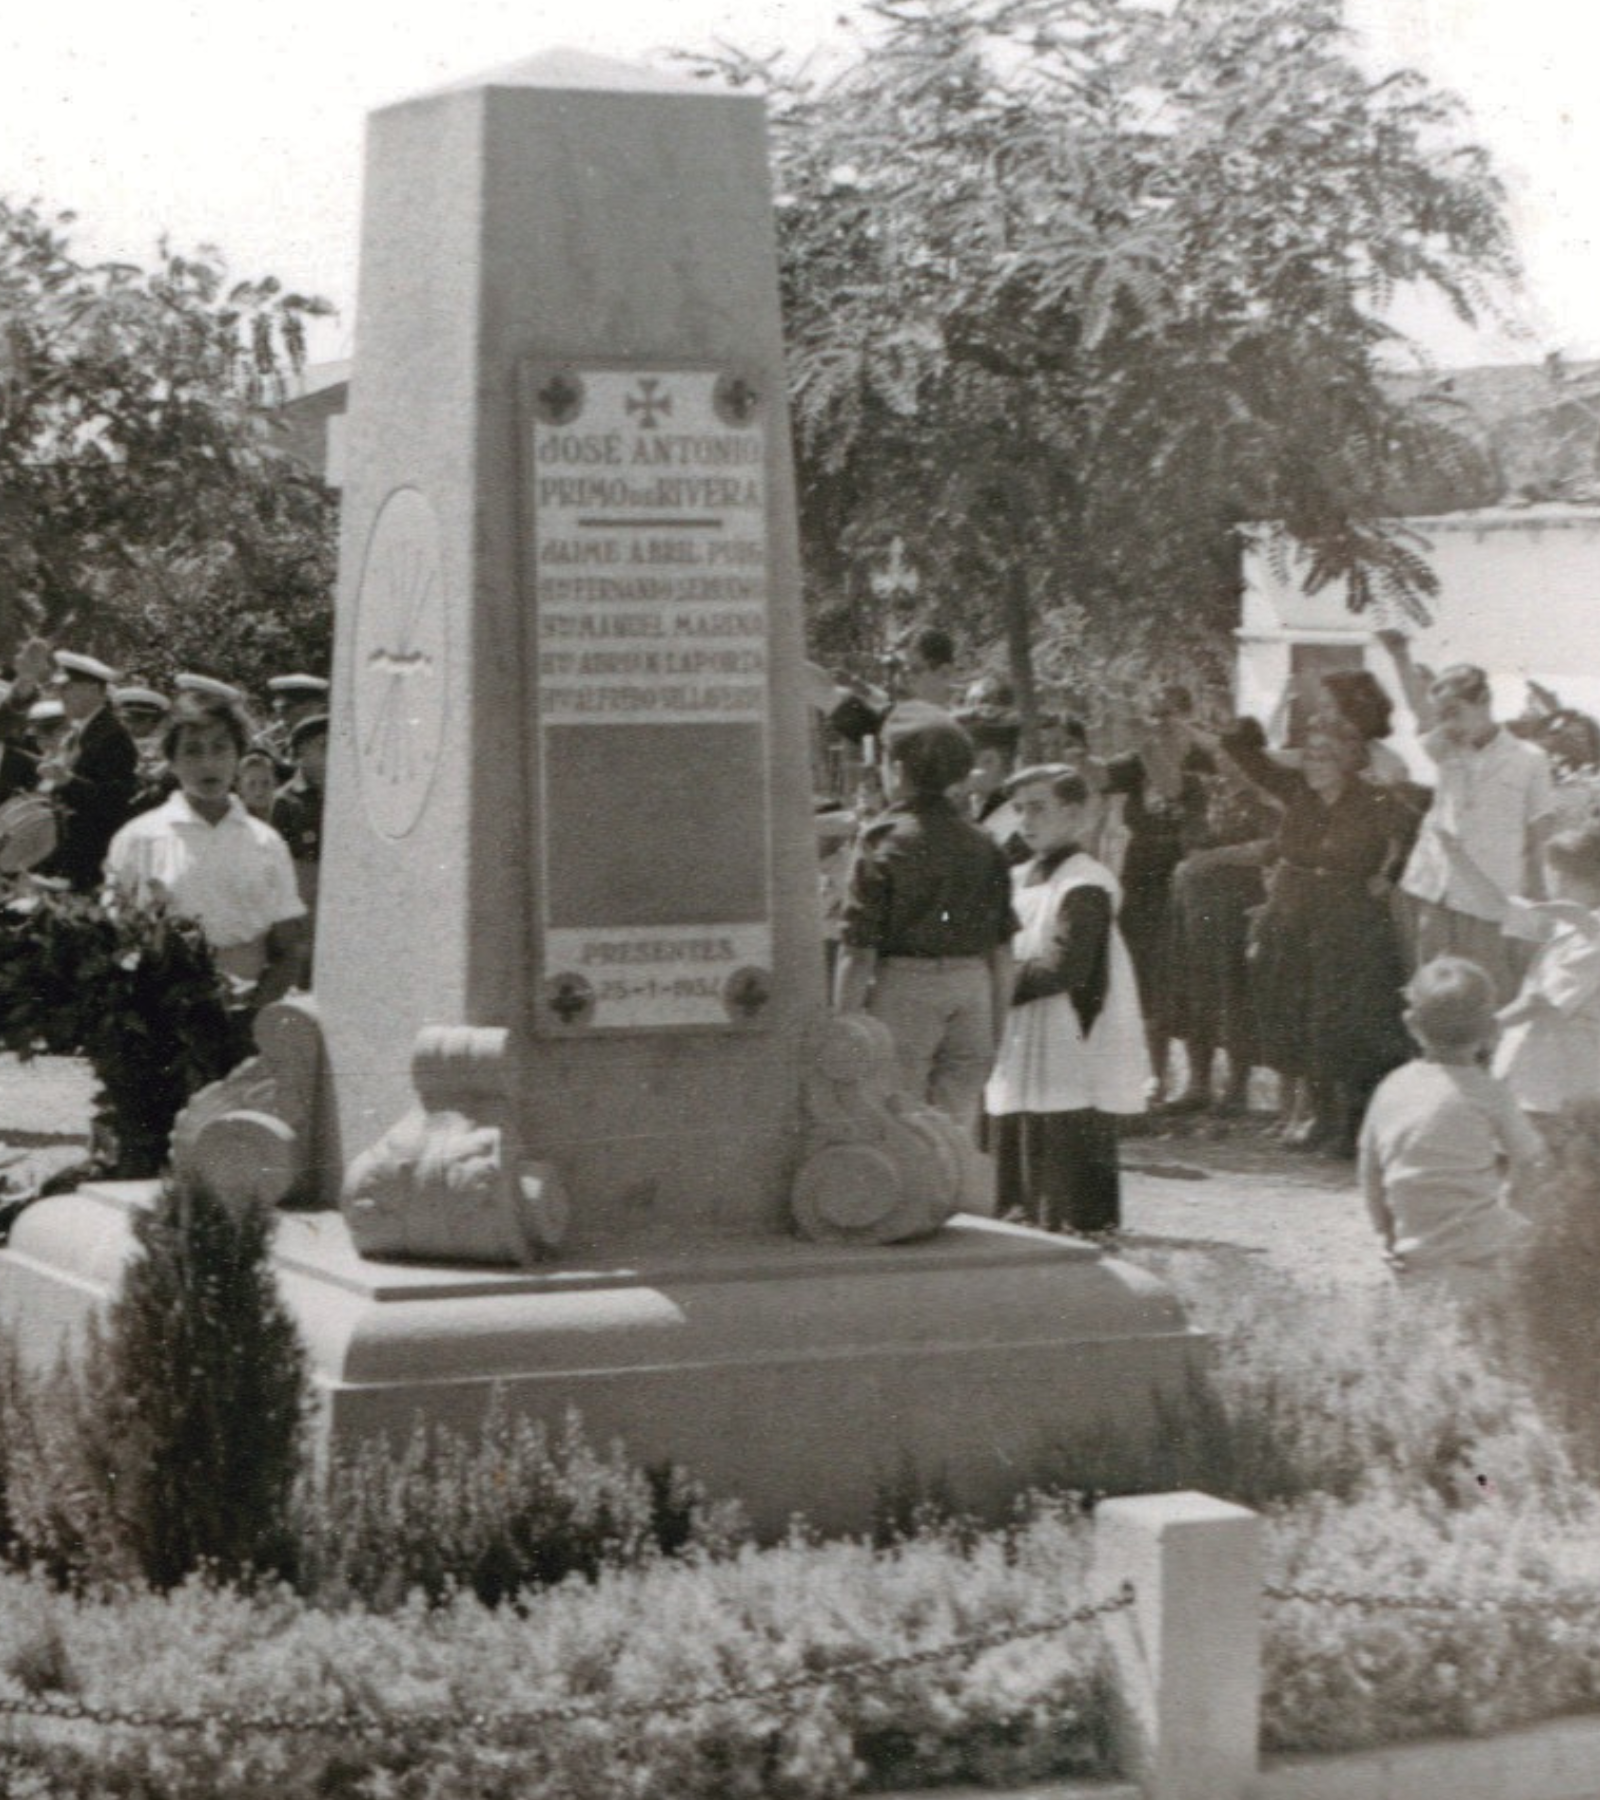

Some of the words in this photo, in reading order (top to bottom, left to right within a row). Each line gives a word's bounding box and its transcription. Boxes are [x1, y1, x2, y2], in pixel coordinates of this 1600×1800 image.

[539, 429, 623, 466] JOSÉ
[631, 434, 761, 466] ANTONIO
[540, 477, 628, 508] PRIMO
[657, 477, 761, 508] RIVERA
